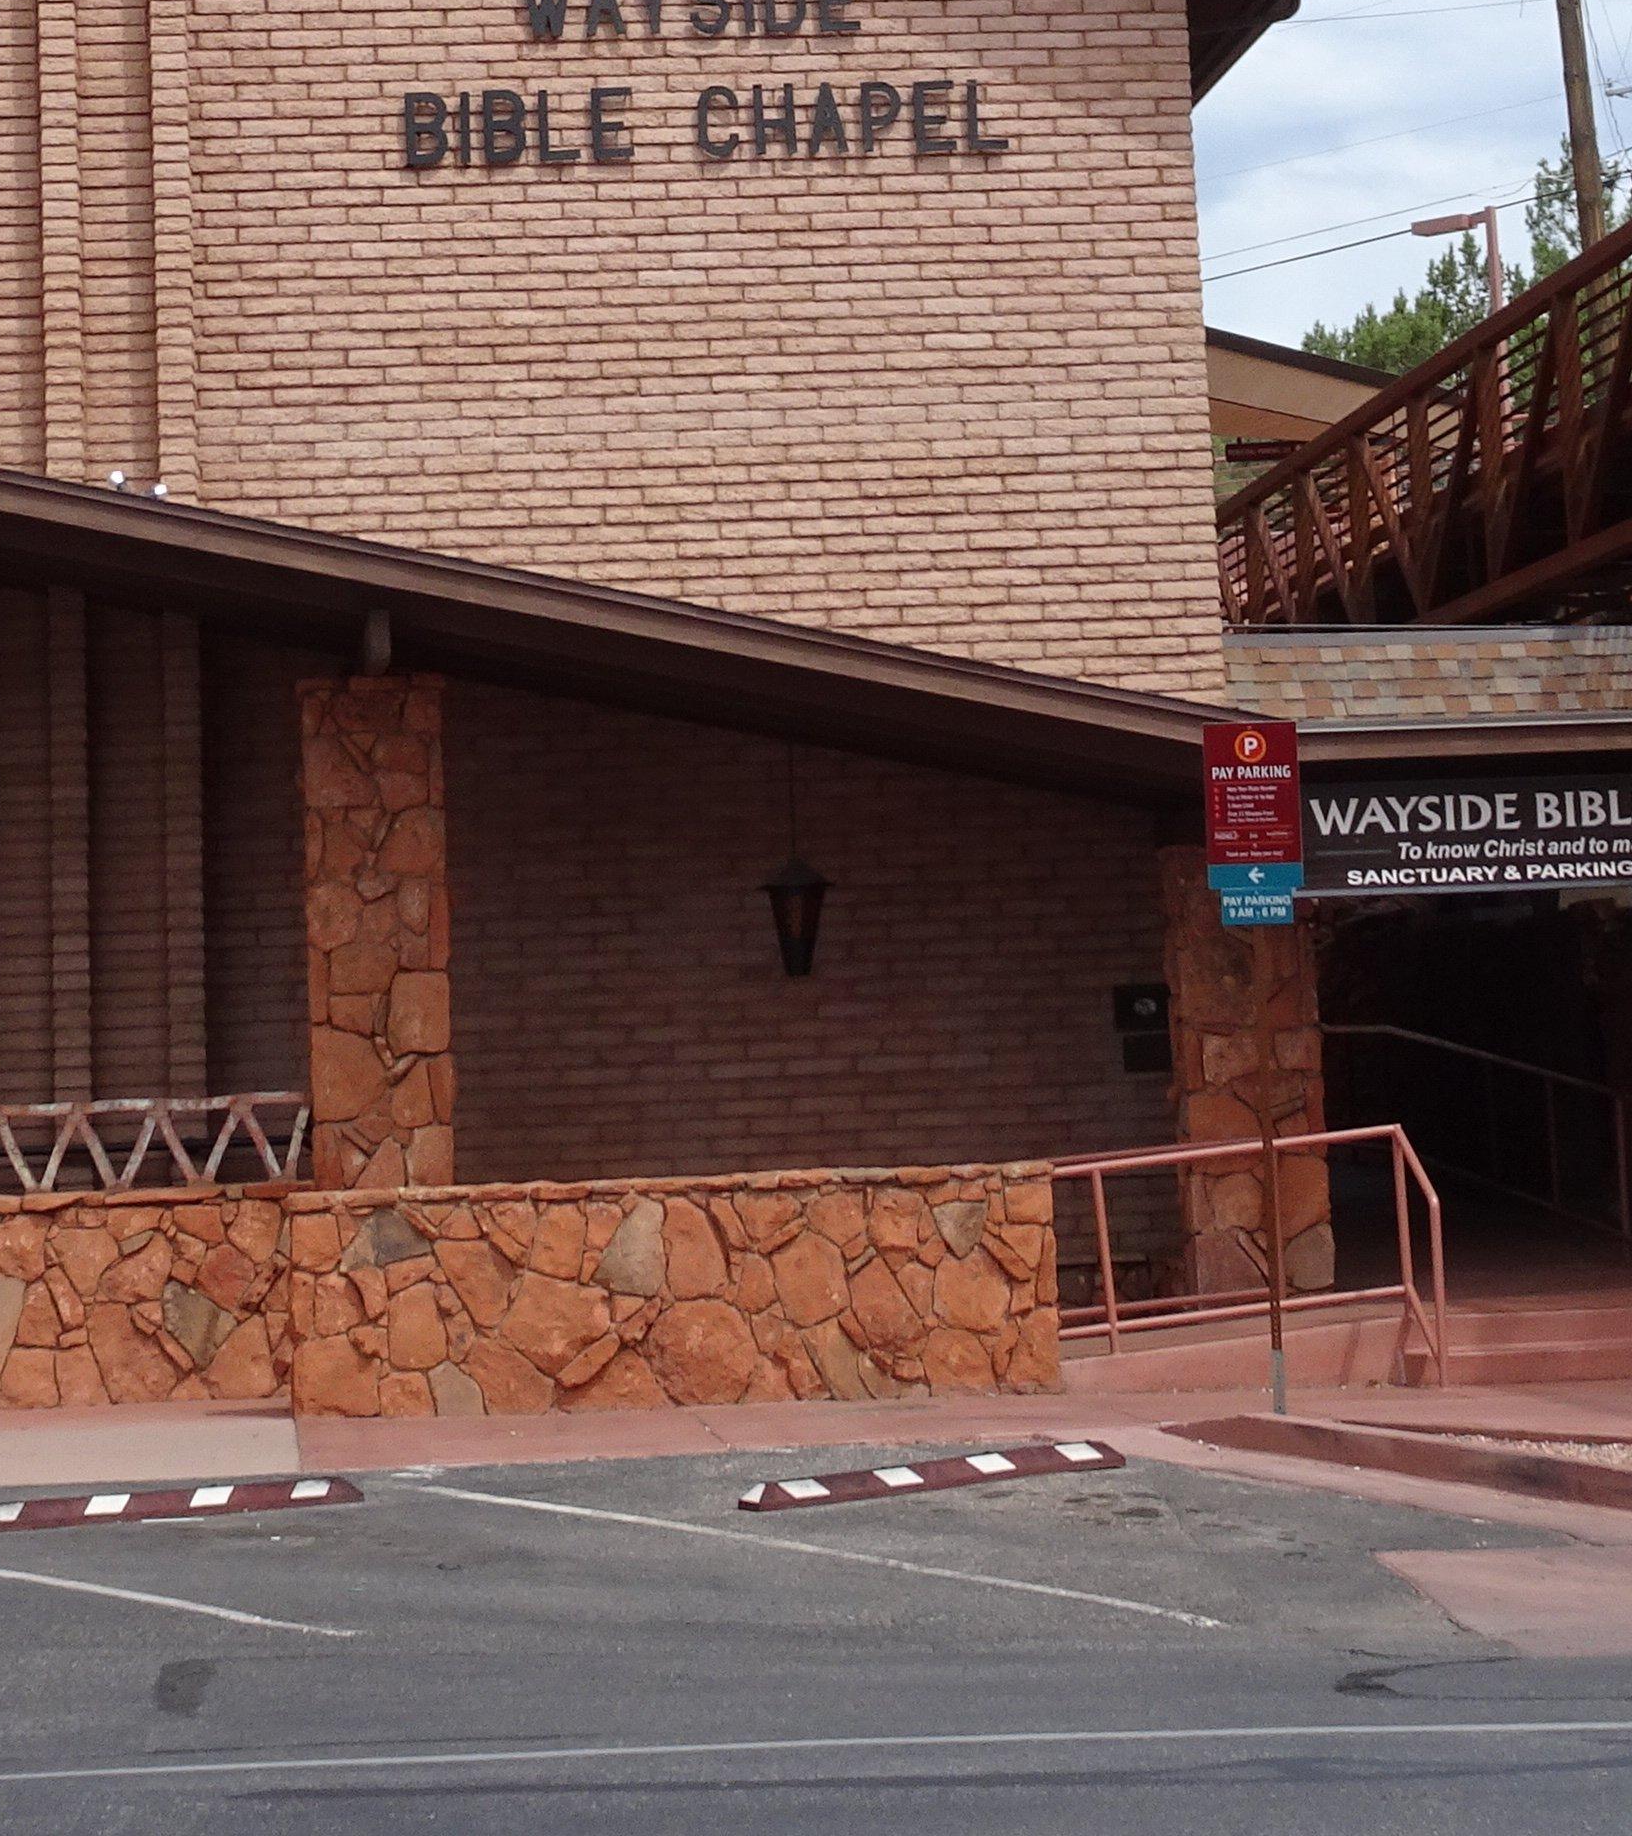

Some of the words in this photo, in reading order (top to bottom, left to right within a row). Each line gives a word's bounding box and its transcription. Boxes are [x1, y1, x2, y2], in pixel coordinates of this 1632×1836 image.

[402, 86, 635, 168] BIBLE
[697, 78, 1010, 158] CHAPEL
[1243, 737, 1258, 756] P
[1211, 766, 1234, 780] PAY
[1237, 764, 1291, 779] PARKING
[1309, 791, 1521, 836] WAYSIDE
[1398, 841, 1419, 860] To
[1425, 839, 1481, 860] know
[1483, 838, 1545, 858] Christ
[1546, 836, 1585, 855] and
[1588, 836, 1609, 855] to
[1346, 865, 1500, 886] SANCTUARY
[1504, 865, 1522, 881] &
[1223, 895, 1243, 907] PAY
[1244, 894, 1292, 906] PARKING
[1237, 907, 1254, 918] AM
[1269, 906, 1287, 917] PM
